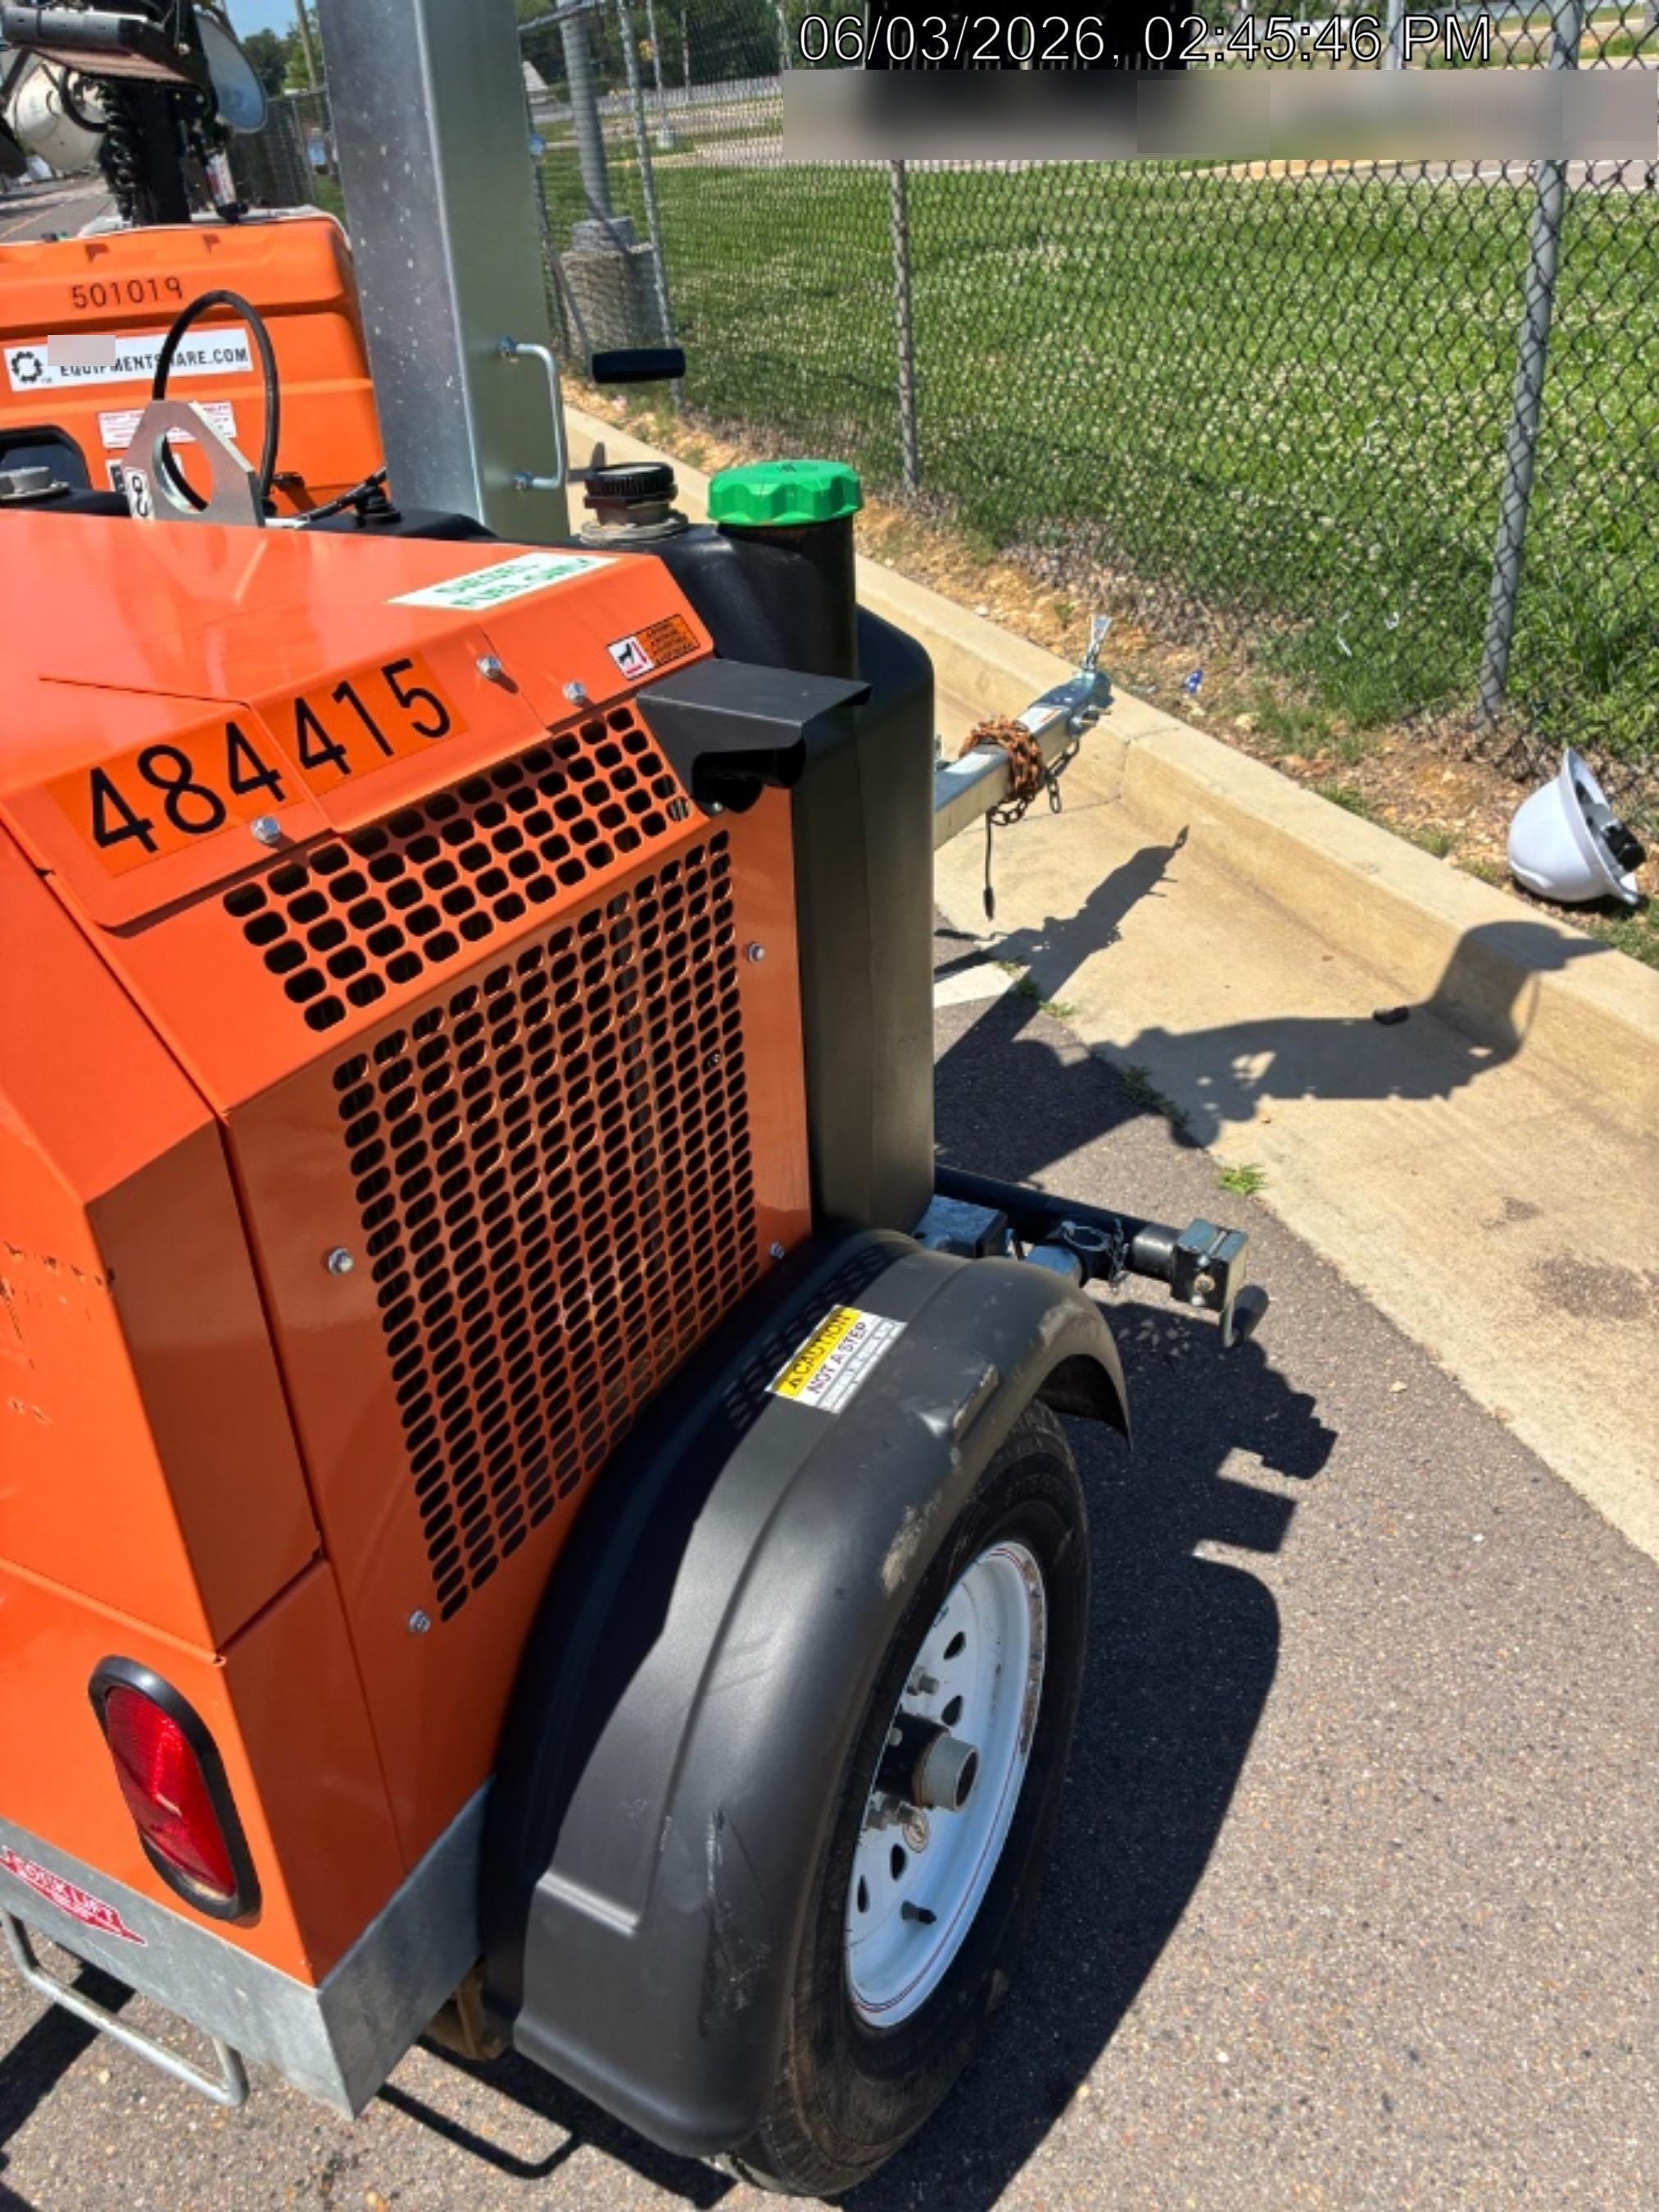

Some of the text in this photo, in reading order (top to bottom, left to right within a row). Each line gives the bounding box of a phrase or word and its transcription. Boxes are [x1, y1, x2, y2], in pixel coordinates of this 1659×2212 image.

[71, 274, 183, 309] 501019
[60, 348, 249, 377] EQUMENTSARE.COM
[89, 658, 451, 854] 484415
[794, 1312, 852, 1374] CAUTION
[807, 1321, 866, 1394] NOT A STEP
